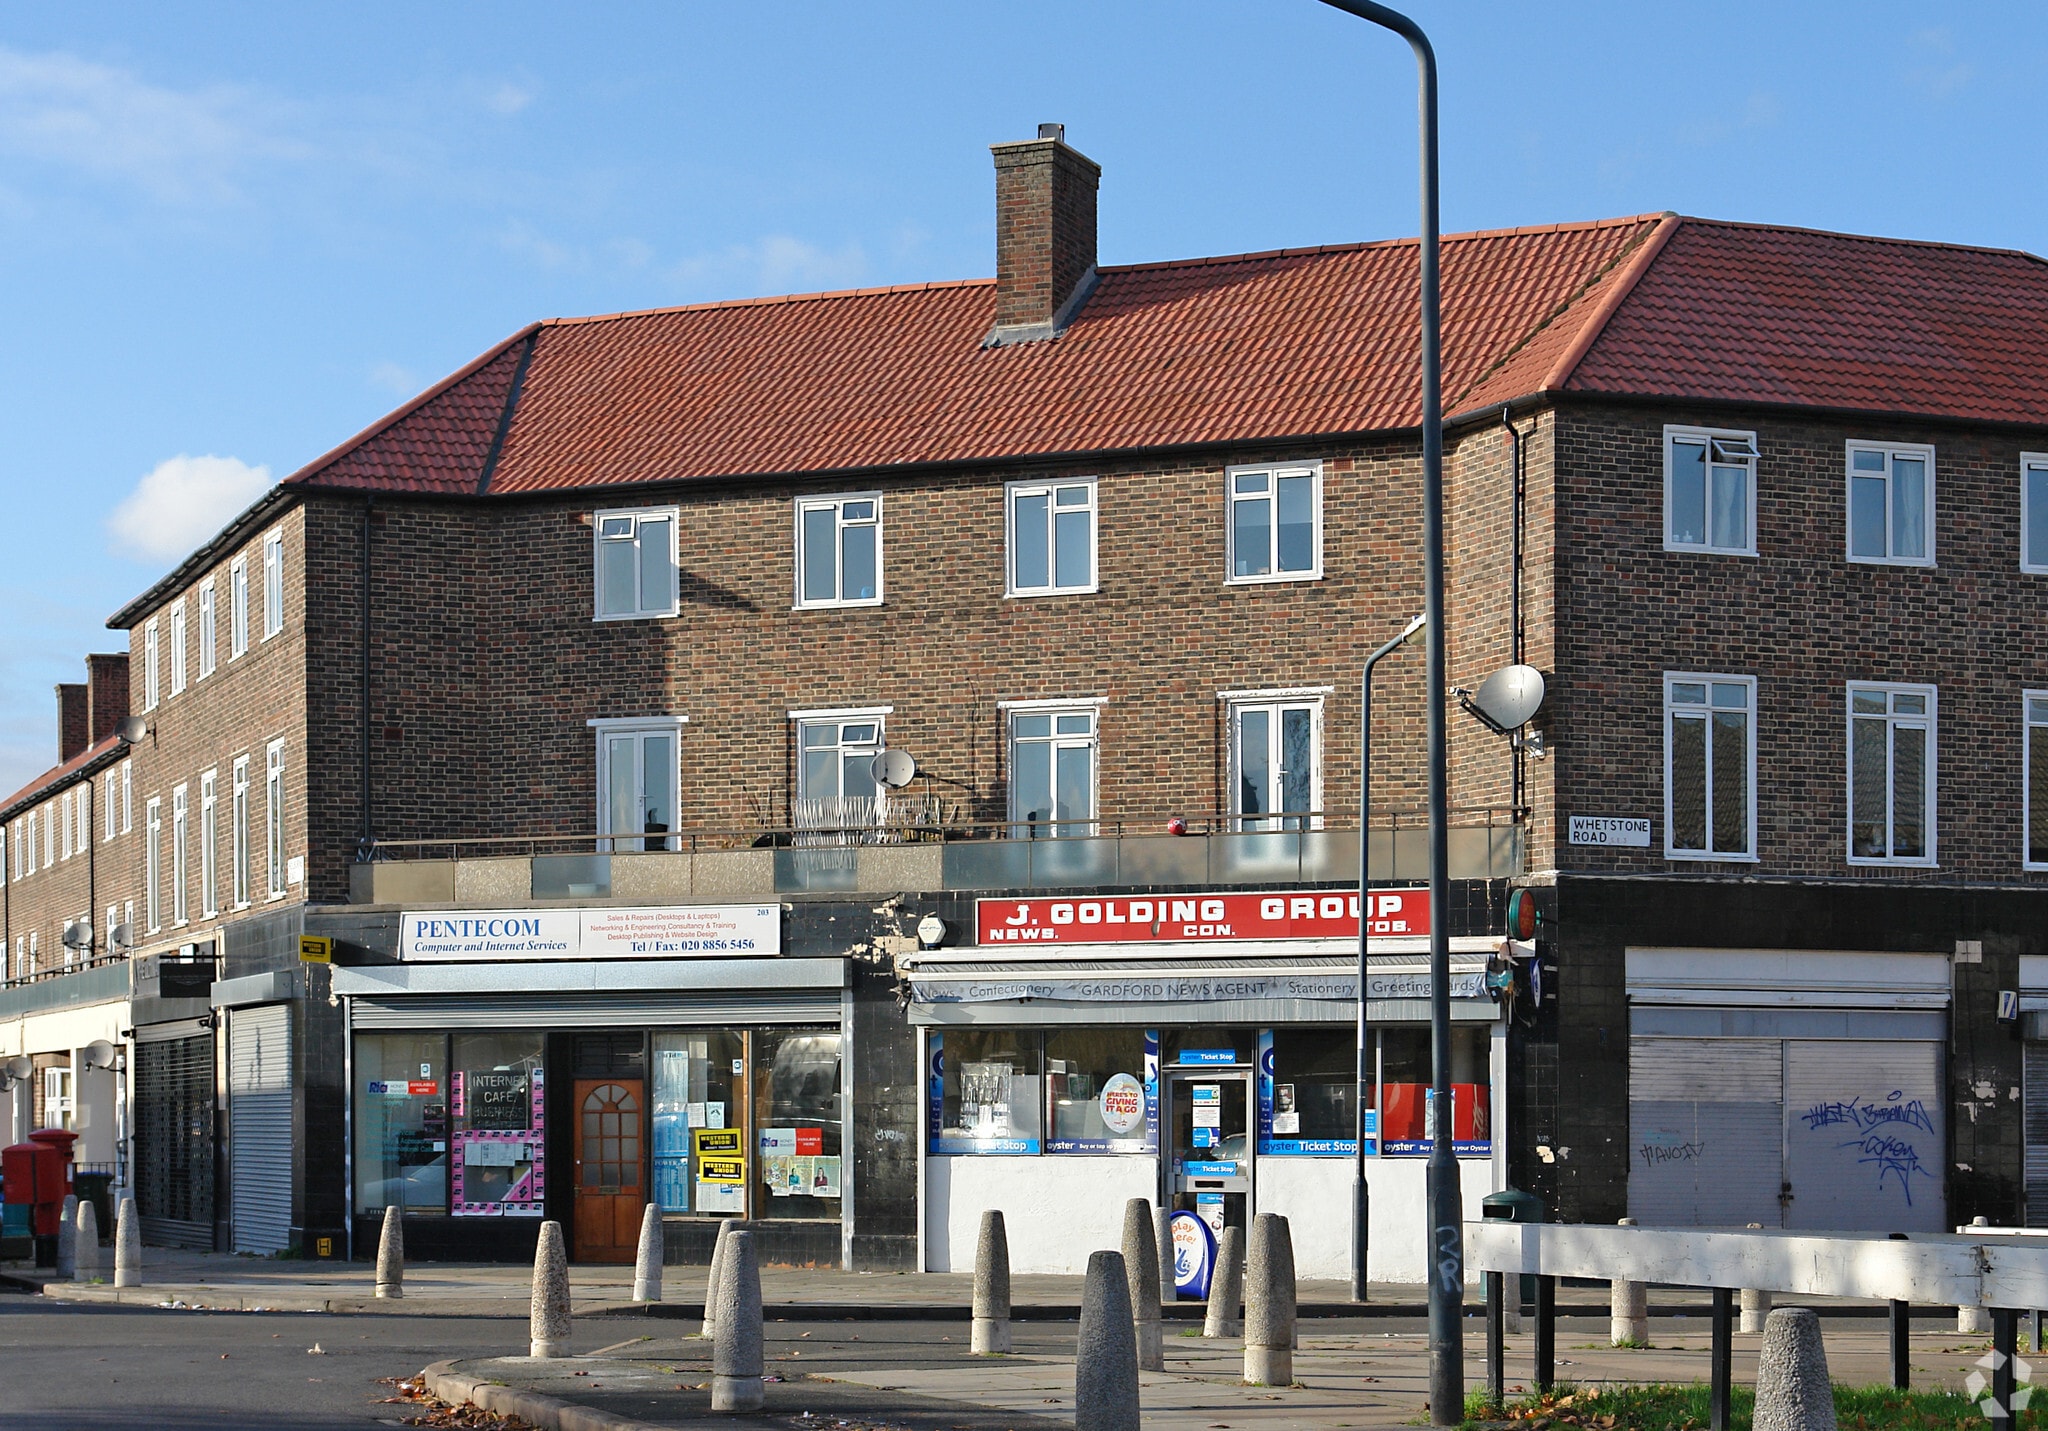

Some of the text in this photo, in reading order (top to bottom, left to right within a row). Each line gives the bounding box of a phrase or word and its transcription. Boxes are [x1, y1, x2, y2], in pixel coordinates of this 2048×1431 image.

[1574, 819, 1648, 832] WHETSTONE
[1573, 831, 1607, 842] ROAD
[1005, 895, 1402, 926] J. GOLDING GROUP
[607, 914, 624, 922] Sales
[631, 914, 655, 923] Repairs
[655, 913, 686, 922] (Desktops
[693, 912, 721, 921] Laptops)
[416, 919, 541, 938] PENTECOM
[590, 924, 624, 932] Networking
[712, 921, 737, 930] Training
[990, 928, 1058, 940] NEWS.
[1183, 924, 1235, 936] CON.
[608, 933, 632, 941] Desktop
[633, 932, 664, 940] Publishing
[671, 931, 695, 939] Website
[696, 930, 718, 938] Design
[414, 940, 568, 954] Computer and Internet Services
[630, 941, 646, 951] Tel
[655, 941, 679, 951] Fax:
[681, 940, 700, 950] 020
[702, 939, 727, 950] 8856
[729, 939, 755, 949] 5456
[969, 984, 1056, 997] Confectionery
[1082, 984, 1162, 996] GARDFORD
[1168, 983, 1210, 995] NEWS
[1215, 982, 1266, 994] AGENT
[1289, 981, 1356, 995] Stationery
[1372, 981, 1431, 994] Greeting
[1449, 980, 1475, 991] ards
[1219, 1053, 1234, 1061] Stop
[472, 1075, 526, 1087] INTERNET
[484, 1091, 514, 1103] CAFE
[1004, 1140, 1027, 1151] Stop
[1047, 1141, 1075, 1151] oyster
[1263, 1140, 1358, 1153] oyster Ticket Stop
[1385, 1142, 1415, 1152] oyster
[1170, 1222, 1195, 1234] play
